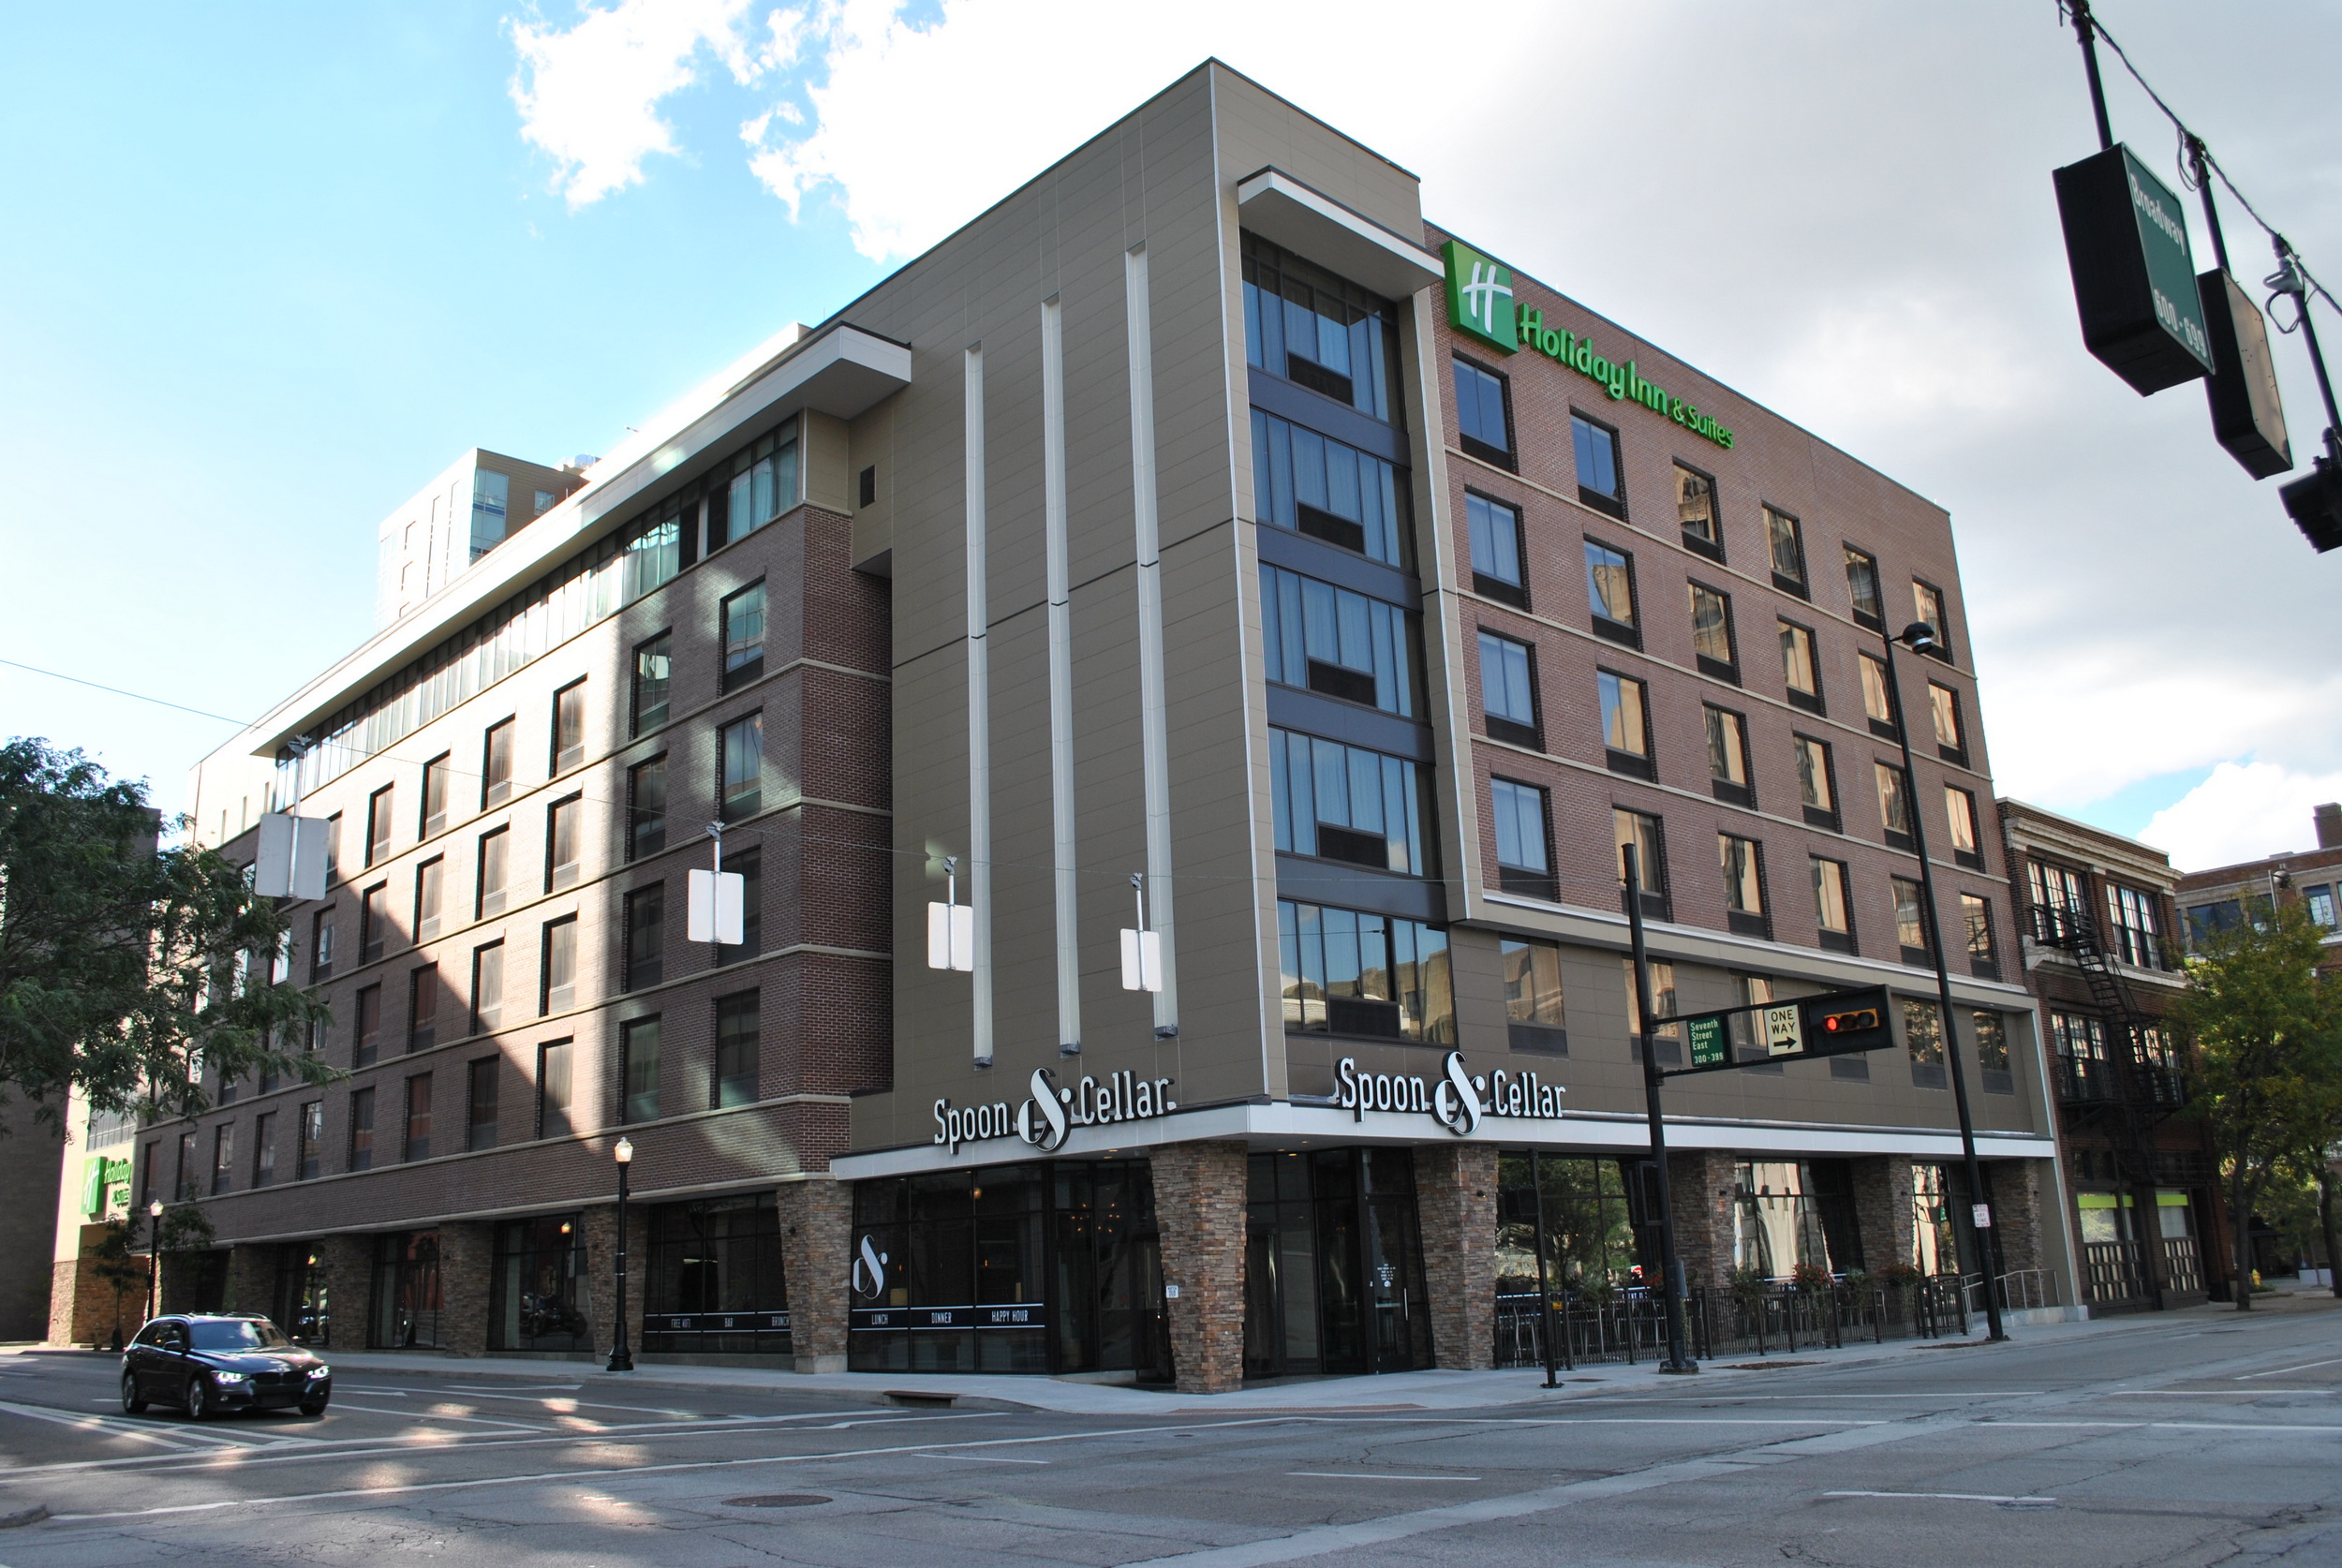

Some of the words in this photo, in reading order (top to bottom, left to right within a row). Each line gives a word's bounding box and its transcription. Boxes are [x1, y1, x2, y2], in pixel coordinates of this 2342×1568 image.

[2130, 173, 2186, 257] Broadway
[1518, 303, 1625, 400] Holiday
[1624, 360, 1668, 416] Inn
[1670, 397, 1686, 426] &
[1685, 405, 1734, 449] Suites
[1771, 1009, 1794, 1022] ONE
[1690, 1019, 1719, 1031] Seventh
[1771, 1022, 1795, 1035] WAY
[1691, 1030, 1712, 1041] Street
[1692, 1041, 1708, 1050] East
[1337, 1057, 1426, 1122] Spoon
[1431, 1050, 1486, 1135] &
[1490, 1069, 1566, 1118] Cellar
[934, 1098, 1011, 1155] Spoon
[1017, 1067, 1076, 1152] &
[1080, 1070, 1174, 1125] Cellar
[724, 1317, 734, 1327] BAR
[871, 1313, 889, 1325] LUNCH
[931, 1311, 953, 1324] DINNER
[991, 1310, 1011, 1323] HAPPY
[1012, 1309, 1029, 1322] HOUR
